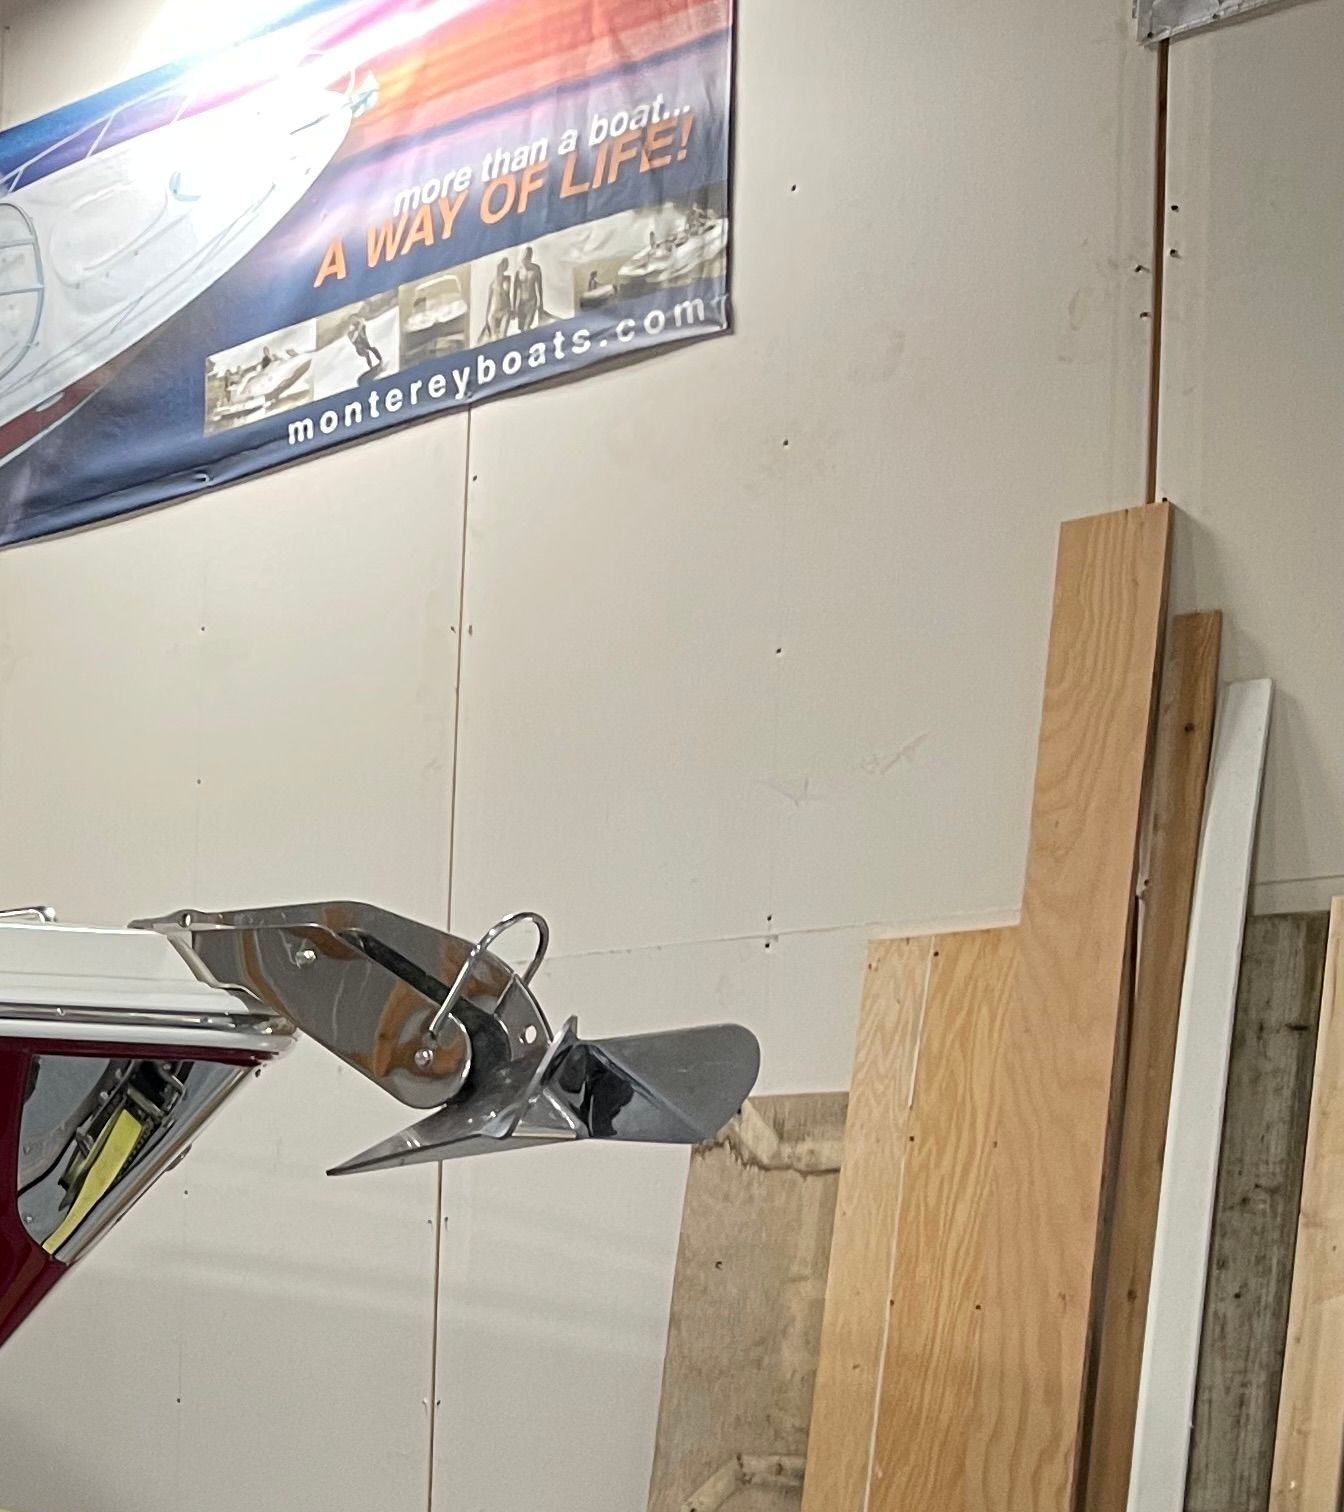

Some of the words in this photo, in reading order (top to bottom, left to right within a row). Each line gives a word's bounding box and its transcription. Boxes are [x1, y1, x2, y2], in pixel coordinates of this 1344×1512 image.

[313, 236, 347, 288] A
[366, 190, 469, 268] WAY
[479, 159, 550, 225] OF
[559, 114, 695, 200] LIFE!
[393, 163, 471, 217] more
[481, 136, 547, 183] than
[557, 128, 577, 155] a
[588, 92, 691, 148] boat...
[287, 294, 707, 446] montereyboats.com
